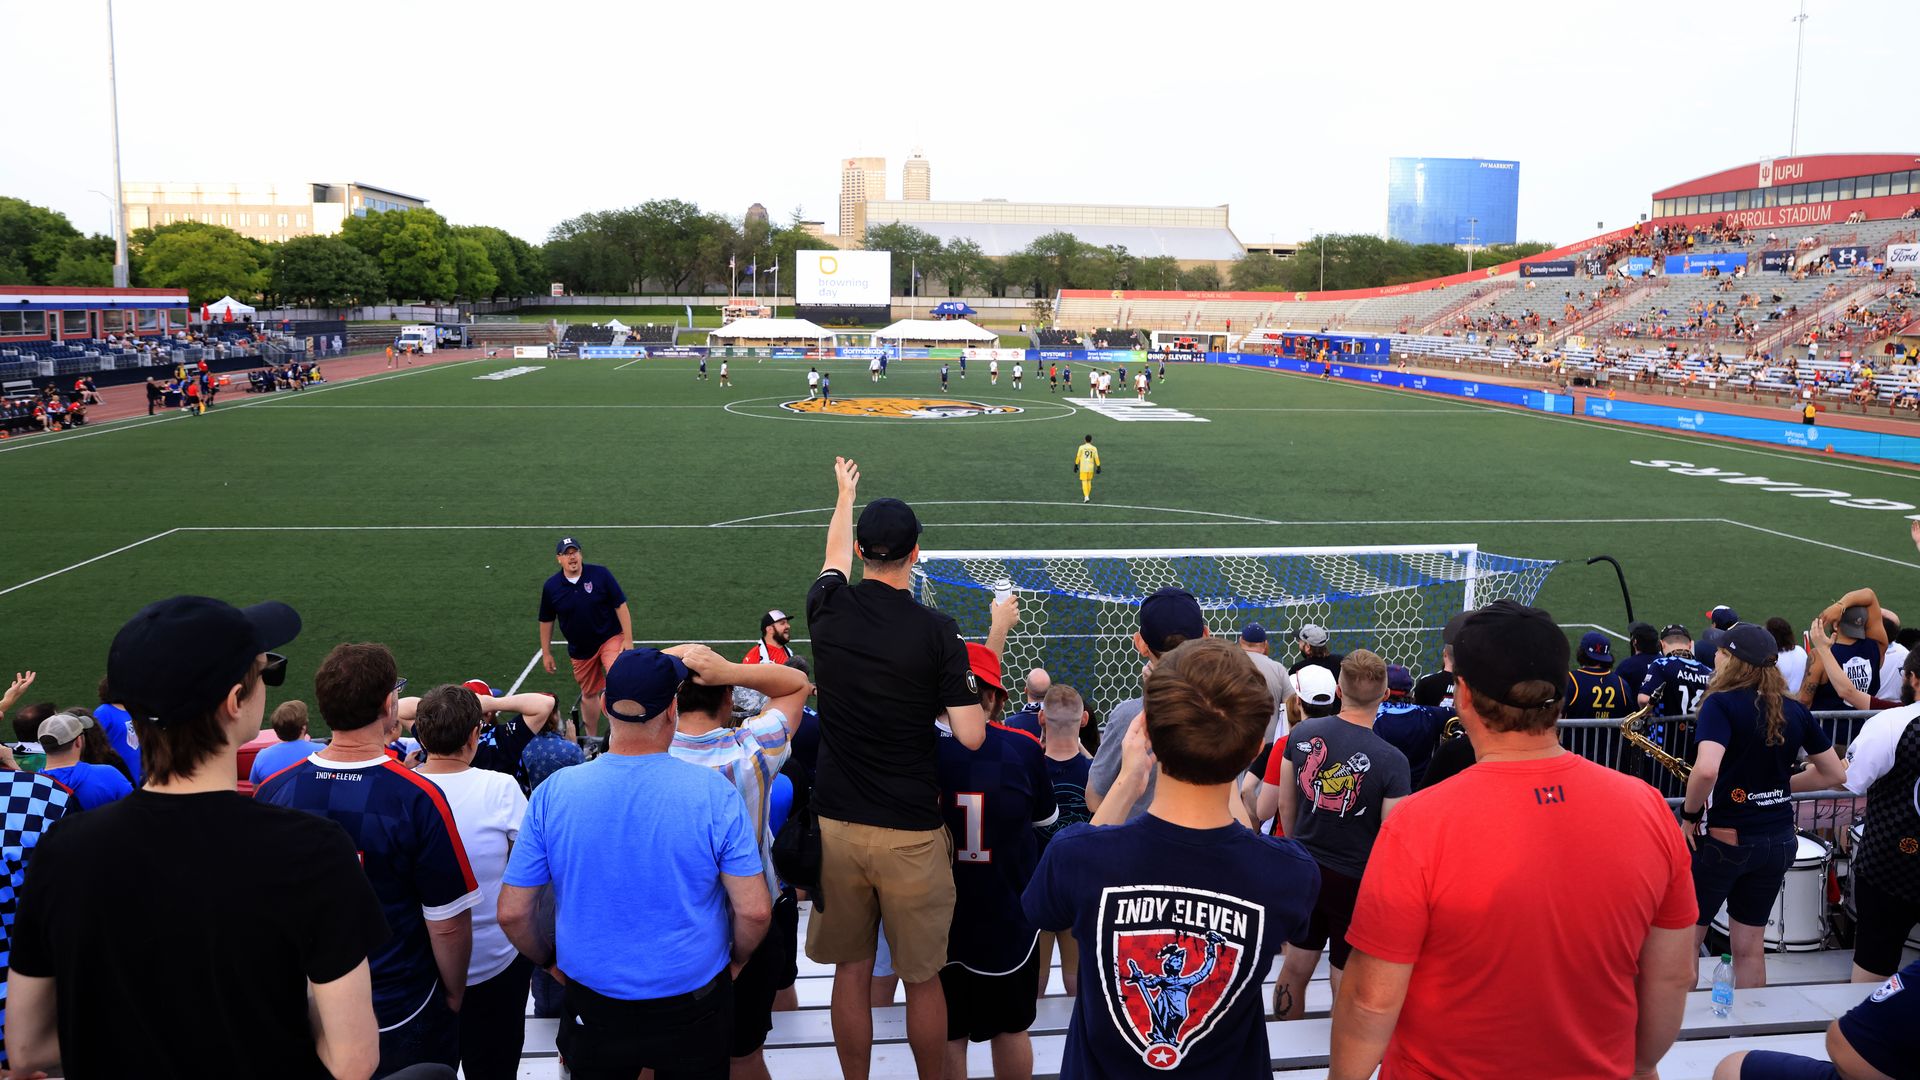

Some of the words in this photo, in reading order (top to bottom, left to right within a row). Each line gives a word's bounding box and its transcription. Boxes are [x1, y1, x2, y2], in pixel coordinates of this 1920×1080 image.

[1774, 163, 1804, 181] IUPUI
[1725, 210, 1774, 227] CARROLL
[1778, 204, 1832, 225] STADIUM
[1891, 248, 1918, 263] Ford
[1530, 266, 1548, 274] Community
[1586, 261, 1601, 275] Taft
[819, 278, 869, 289] browning
[819, 288, 838, 298] day
[1677, 415, 1693, 423] Johnson
[1785, 430, 1805, 439] Johnson
[1787, 437, 1808, 446] Controls
[1085, 450, 1093, 459] 91
[1677, 670, 1710, 685] ASANTE
[1847, 664, 1868, 680] BACK
[968, 675, 977, 688] 11
[1592, 685, 1616, 709] 22
[316, 771, 332, 780] INDY
[336, 772, 362, 782] ELEVEN
[1747, 789, 1784, 801] Community
[955, 792, 992, 864] 1
[1114, 897, 1170, 925] INDY
[1171, 899, 1248, 939] ELEVEN
